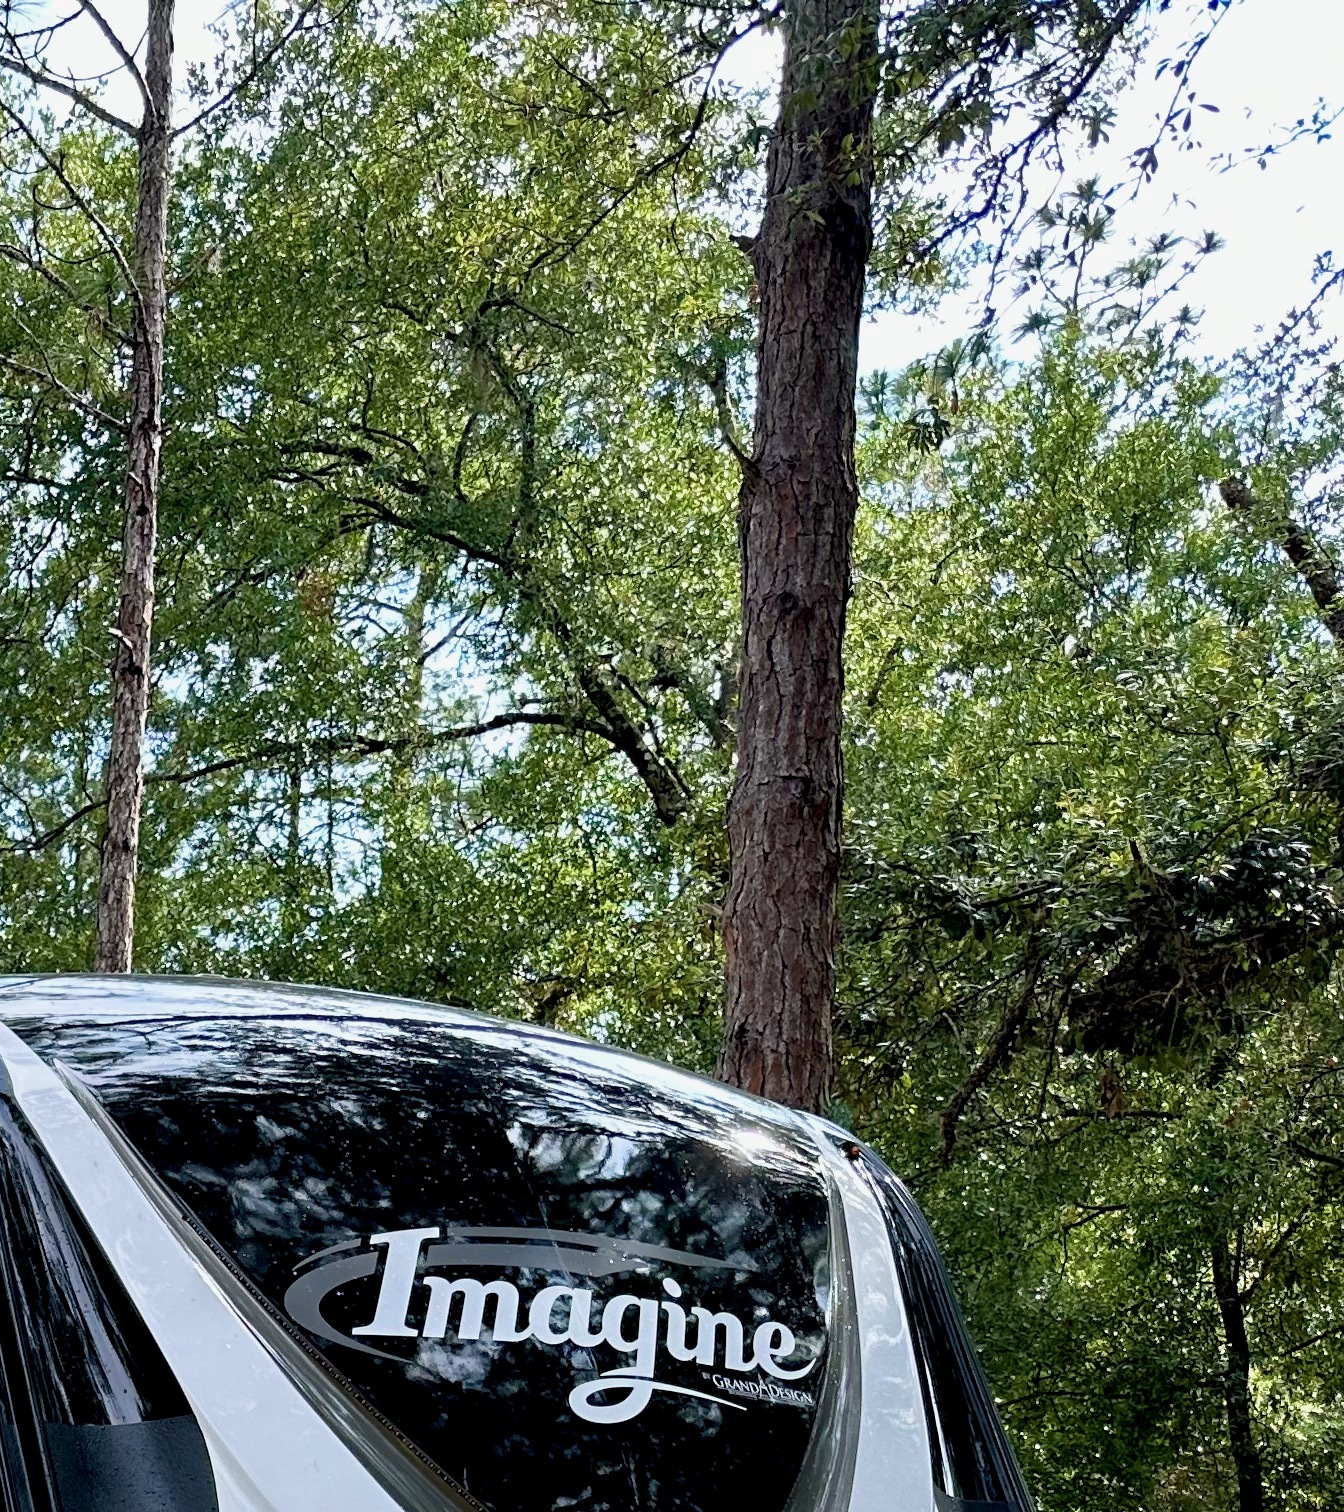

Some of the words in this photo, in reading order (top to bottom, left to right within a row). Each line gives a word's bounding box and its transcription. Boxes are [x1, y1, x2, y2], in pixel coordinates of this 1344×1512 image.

[351, 1227, 817, 1424] Imagine
[712, 1374, 759, 1395] GRAND
[769, 1384, 813, 1404] DESIGN
